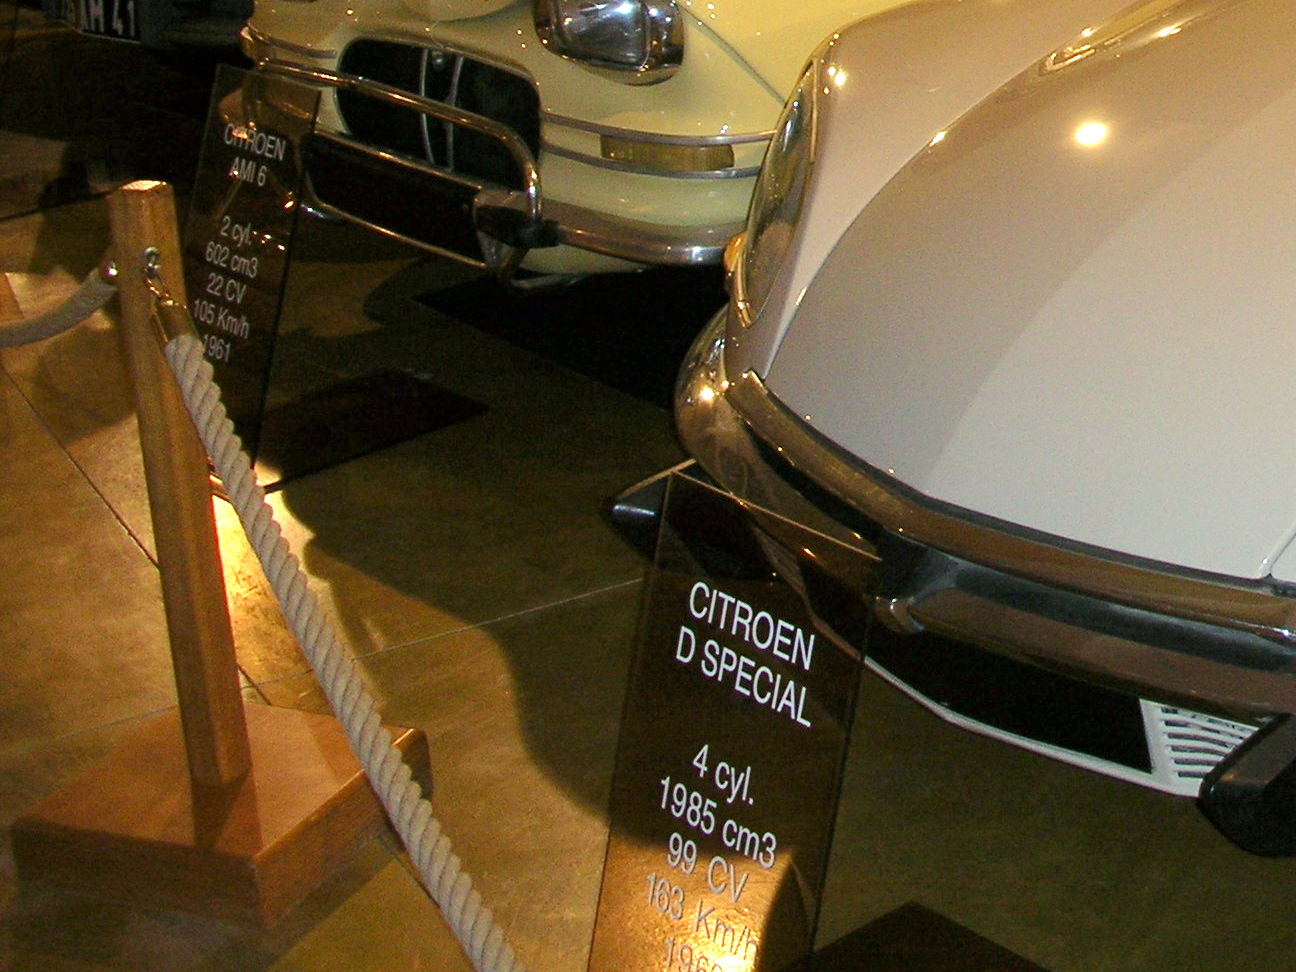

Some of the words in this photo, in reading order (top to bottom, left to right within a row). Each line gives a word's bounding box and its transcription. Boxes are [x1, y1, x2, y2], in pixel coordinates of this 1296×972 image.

[223, 123, 287, 162] CITROEN
[230, 156, 255, 184] AMI
[256, 165, 268, 187] 6
[220, 215, 231, 237] 2
[231, 222, 253, 246] cyl.
[205, 241, 230, 269] 602
[231, 252, 259, 279] cm3
[206, 273, 225, 296] 22
[225, 281, 247, 305] CV
[193, 298, 215, 325] 105
[216, 307, 251, 340] Km/h
[688, 581, 815, 671] CITROEN
[675, 627, 696, 665] D
[700, 640, 813, 727] SPECIAL
[692, 743, 709, 778] 4
[714, 760, 755, 806] cyl.
[660, 776, 716, 835] 1985
[722, 819, 777, 869] cm3
[666, 832, 697, 874] 99
[706, 856, 749, 904] CV
[645, 873, 686, 920] 163
[694, 903, 761, 958] Km/h
